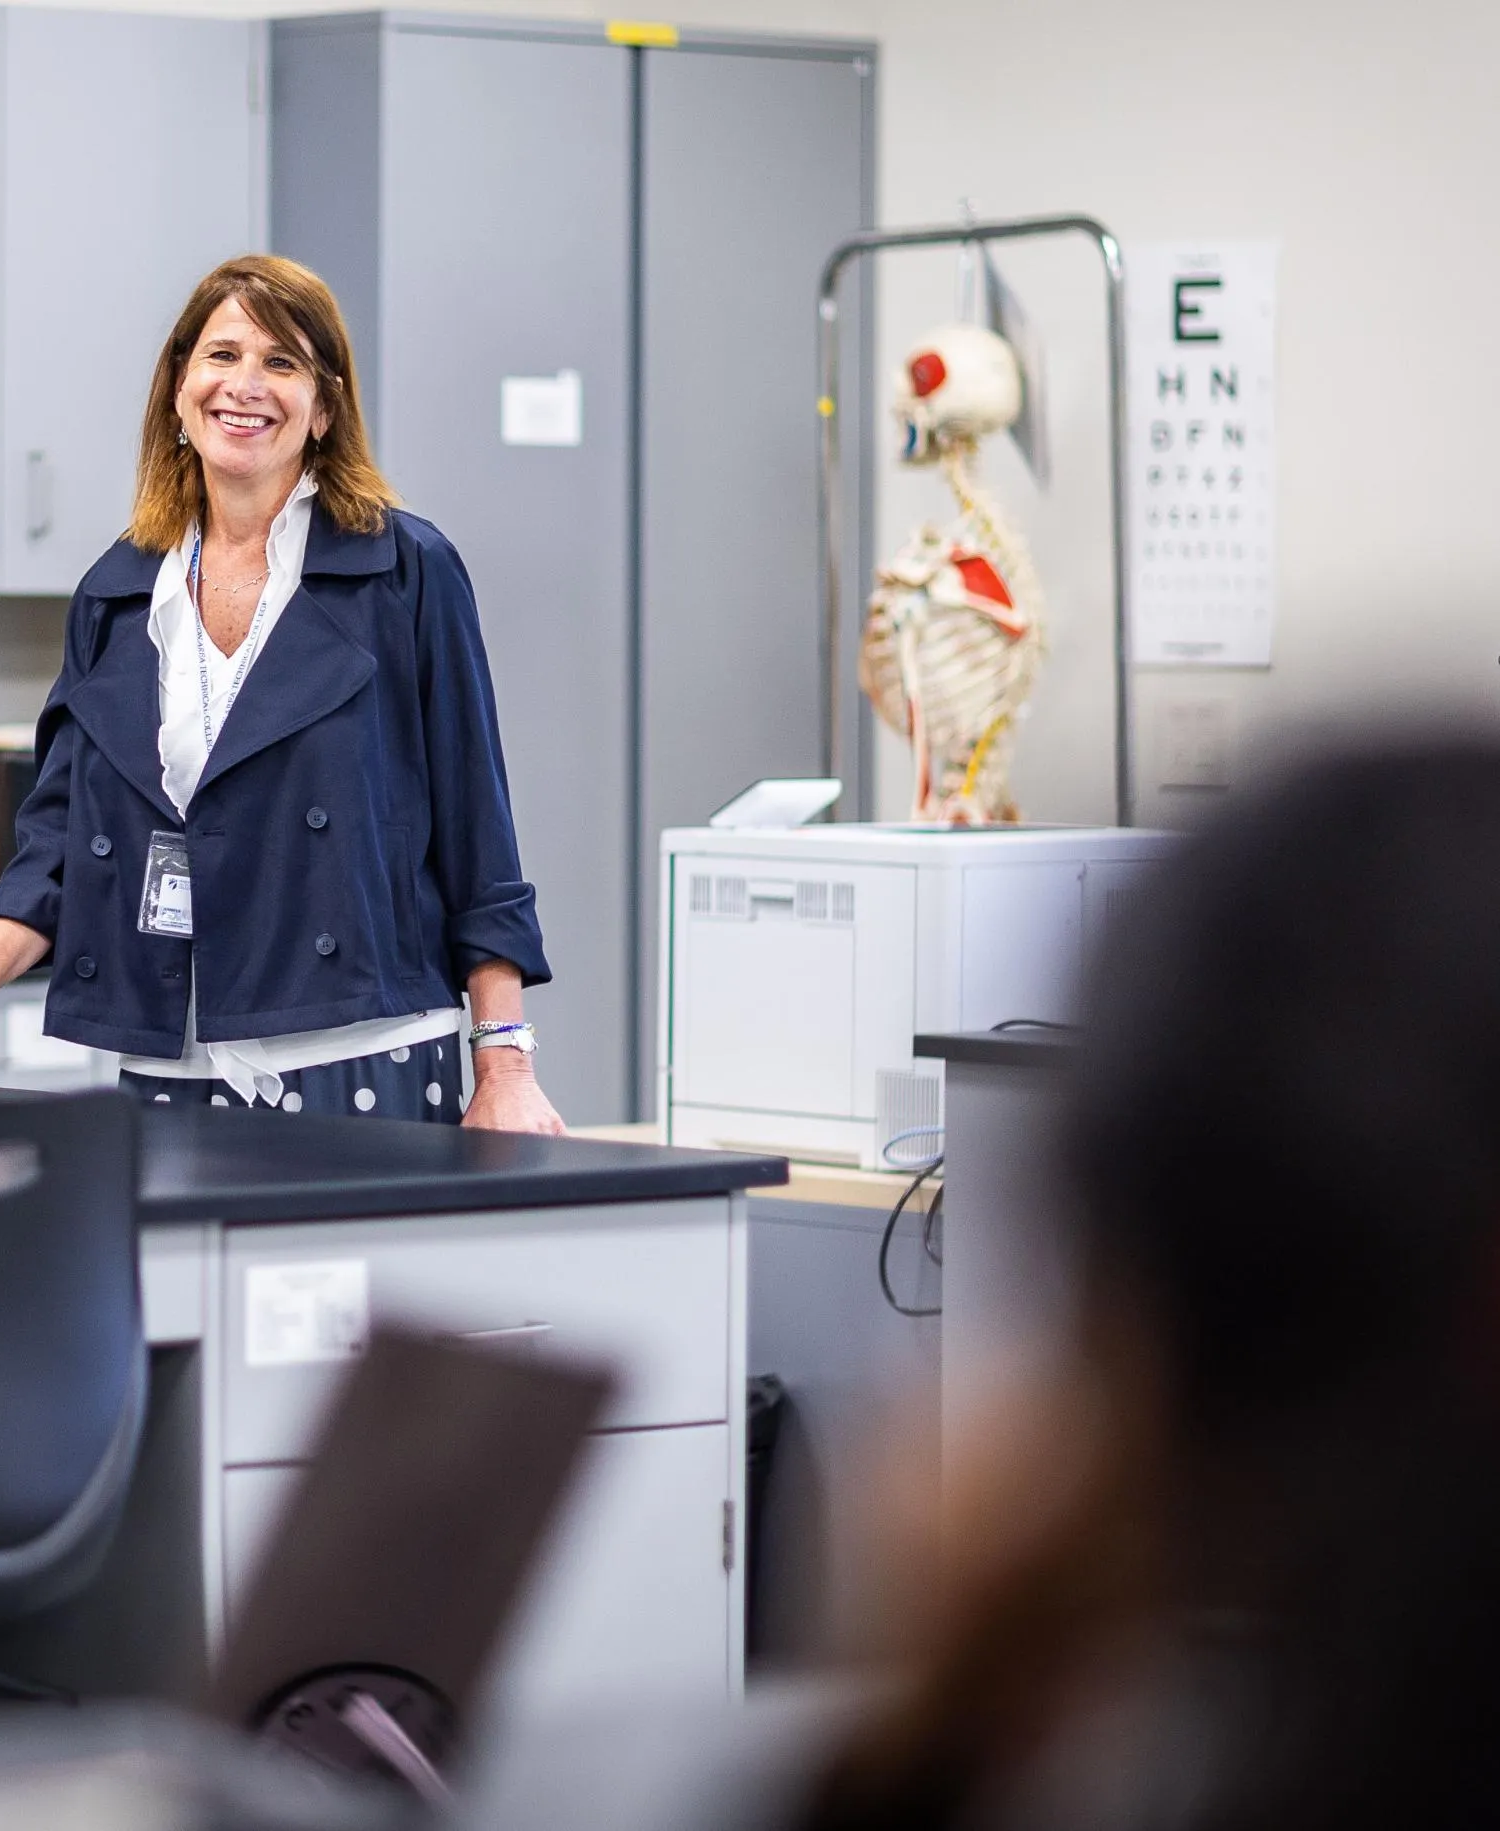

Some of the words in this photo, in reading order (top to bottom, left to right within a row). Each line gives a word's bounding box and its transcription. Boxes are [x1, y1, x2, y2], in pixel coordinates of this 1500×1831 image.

[1174, 277, 1222, 343] E
[1157, 364, 1187, 404] H
[1211, 363, 1238, 404] N
[200, 665, 211, 713] TECHNICAL
[232, 643, 253, 689] TECHNICAL
[203, 715, 214, 754] COLLEG
